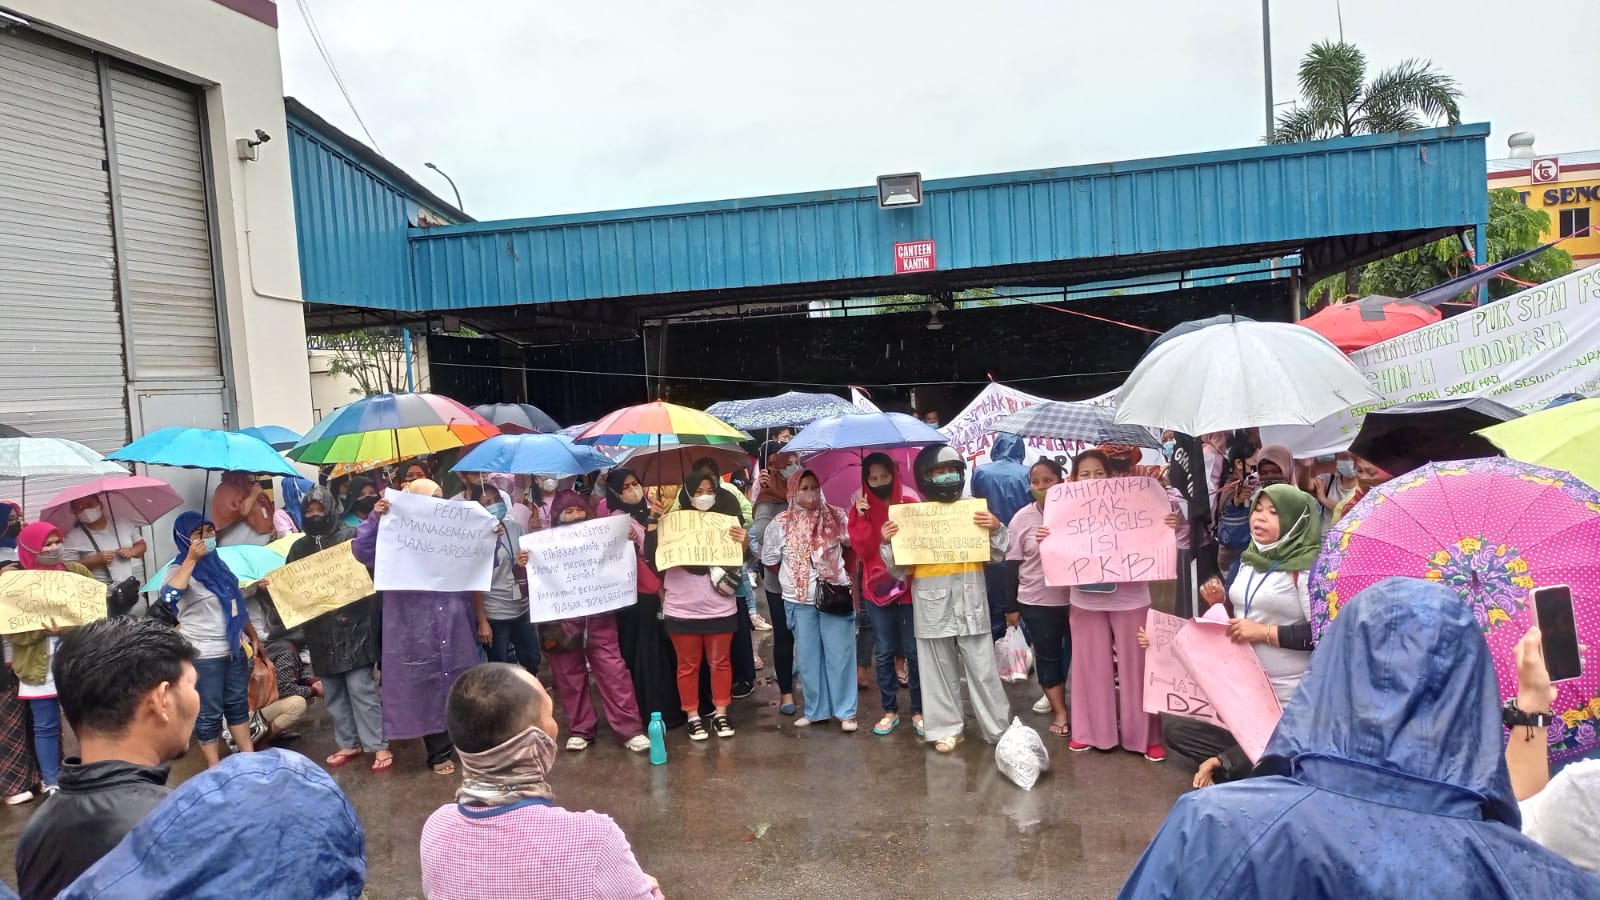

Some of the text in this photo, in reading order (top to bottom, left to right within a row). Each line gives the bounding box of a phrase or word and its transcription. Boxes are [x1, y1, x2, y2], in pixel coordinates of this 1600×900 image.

[898, 243, 932, 257] CANTEEN
[903, 257, 930, 270] KANTIN
[1472, 300, 1514, 337] PUK
[1517, 282, 1567, 322] SPAI
[1456, 321, 1569, 375] INDONESIA
[1514, 373, 1555, 389] SESUAI
[434, 502, 474, 521] PECAT
[1080, 496, 1128, 515] TAK
[400, 517, 485, 540] MANAGEMENT
[922, 519, 951, 535] PKB
[1066, 510, 1153, 536] SEBAGUS
[397, 534, 488, 559] YANG AROGAN
[1090, 533, 1119, 554] ISI
[23, 582, 69, 598] PHK
